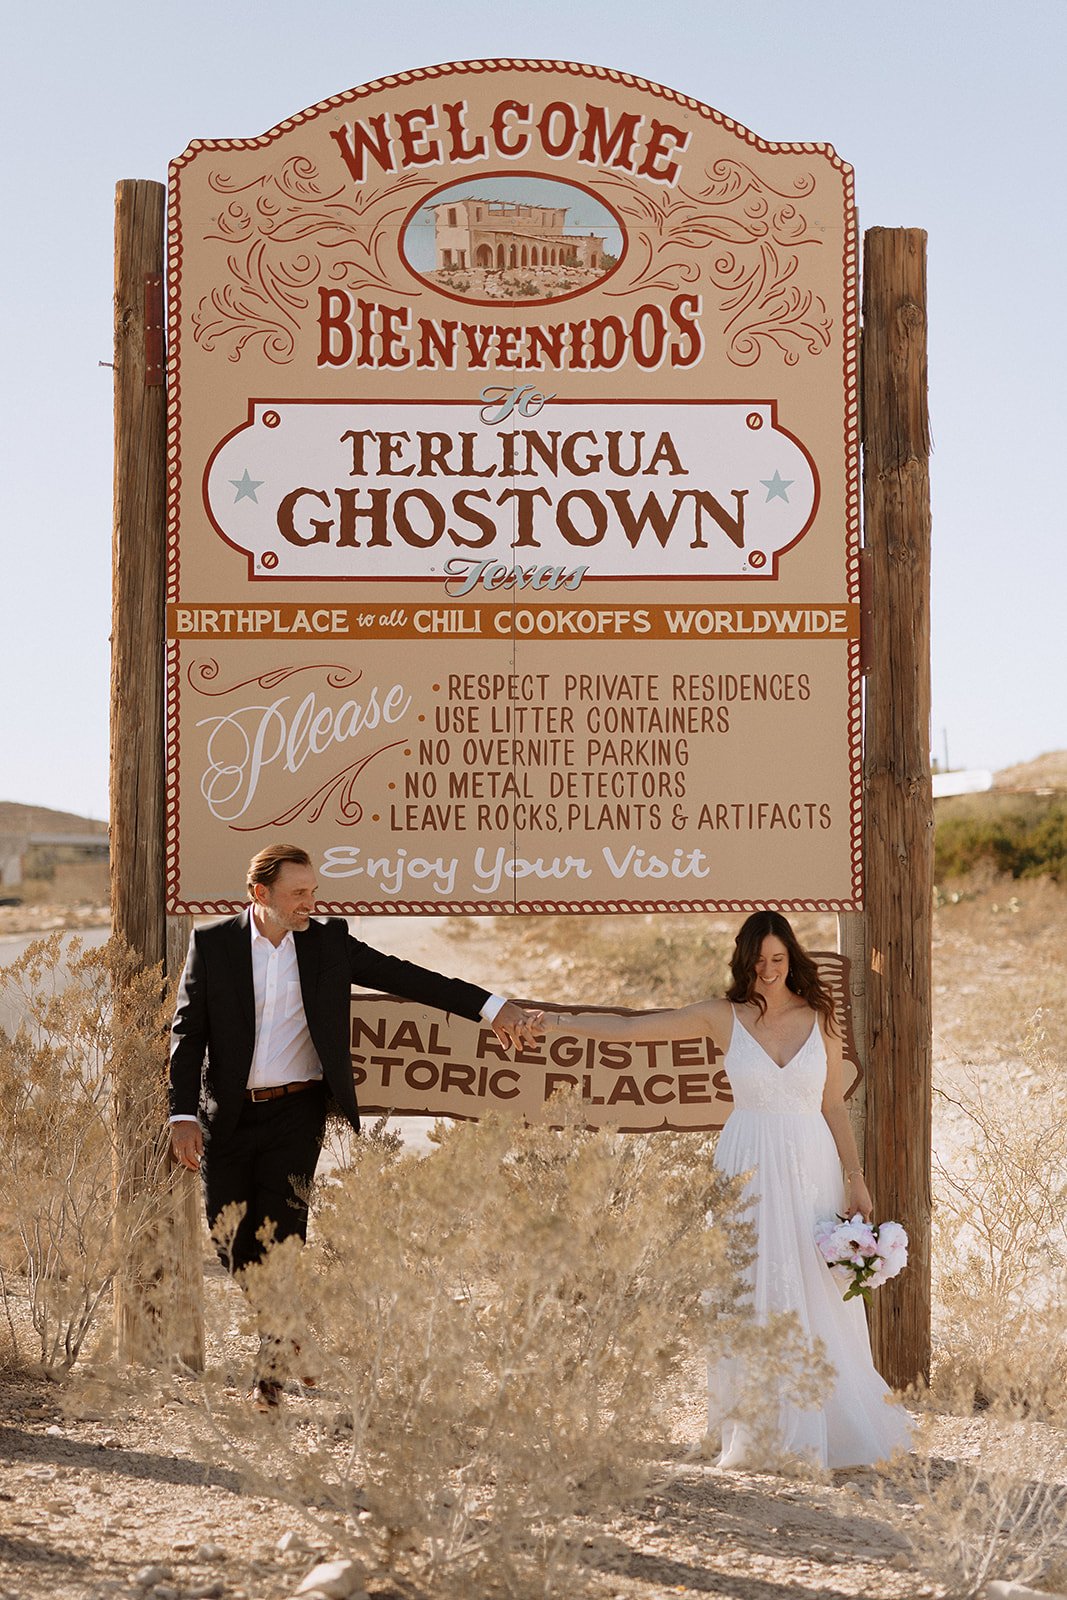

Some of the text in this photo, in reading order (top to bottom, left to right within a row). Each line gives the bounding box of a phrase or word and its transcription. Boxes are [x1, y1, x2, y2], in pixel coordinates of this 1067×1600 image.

[329, 99, 693, 189] WELCOME
[316, 286, 706, 373] BIENVENIDOS
[479, 383, 557, 425] To
[339, 429, 690, 478] TERLINGUA
[276, 486, 749, 549] GHOSTOWN
[443, 557, 590, 598] Texas
[175, 608, 849, 634] BIRTHPLACE to all CHILI COOKOFFS WORLDWIDE
[448, 673, 811, 701] RESPECT PRIVATE RESIDENCES
[435, 705, 730, 733] USE LITTER CONTAINERS
[195, 683, 412, 821] Please
[419, 738, 689, 766] NO OVERNITE PARKING
[405, 771, 686, 798] NO METAL DETECTORS
[390, 804, 467, 831] LEAVE
[671, 803, 689, 831] &
[697, 803, 832, 831] ARTIFACTS
[319, 844, 710, 895] Enjoy Your Visit
[544, 1069, 734, 1106] PLACES
